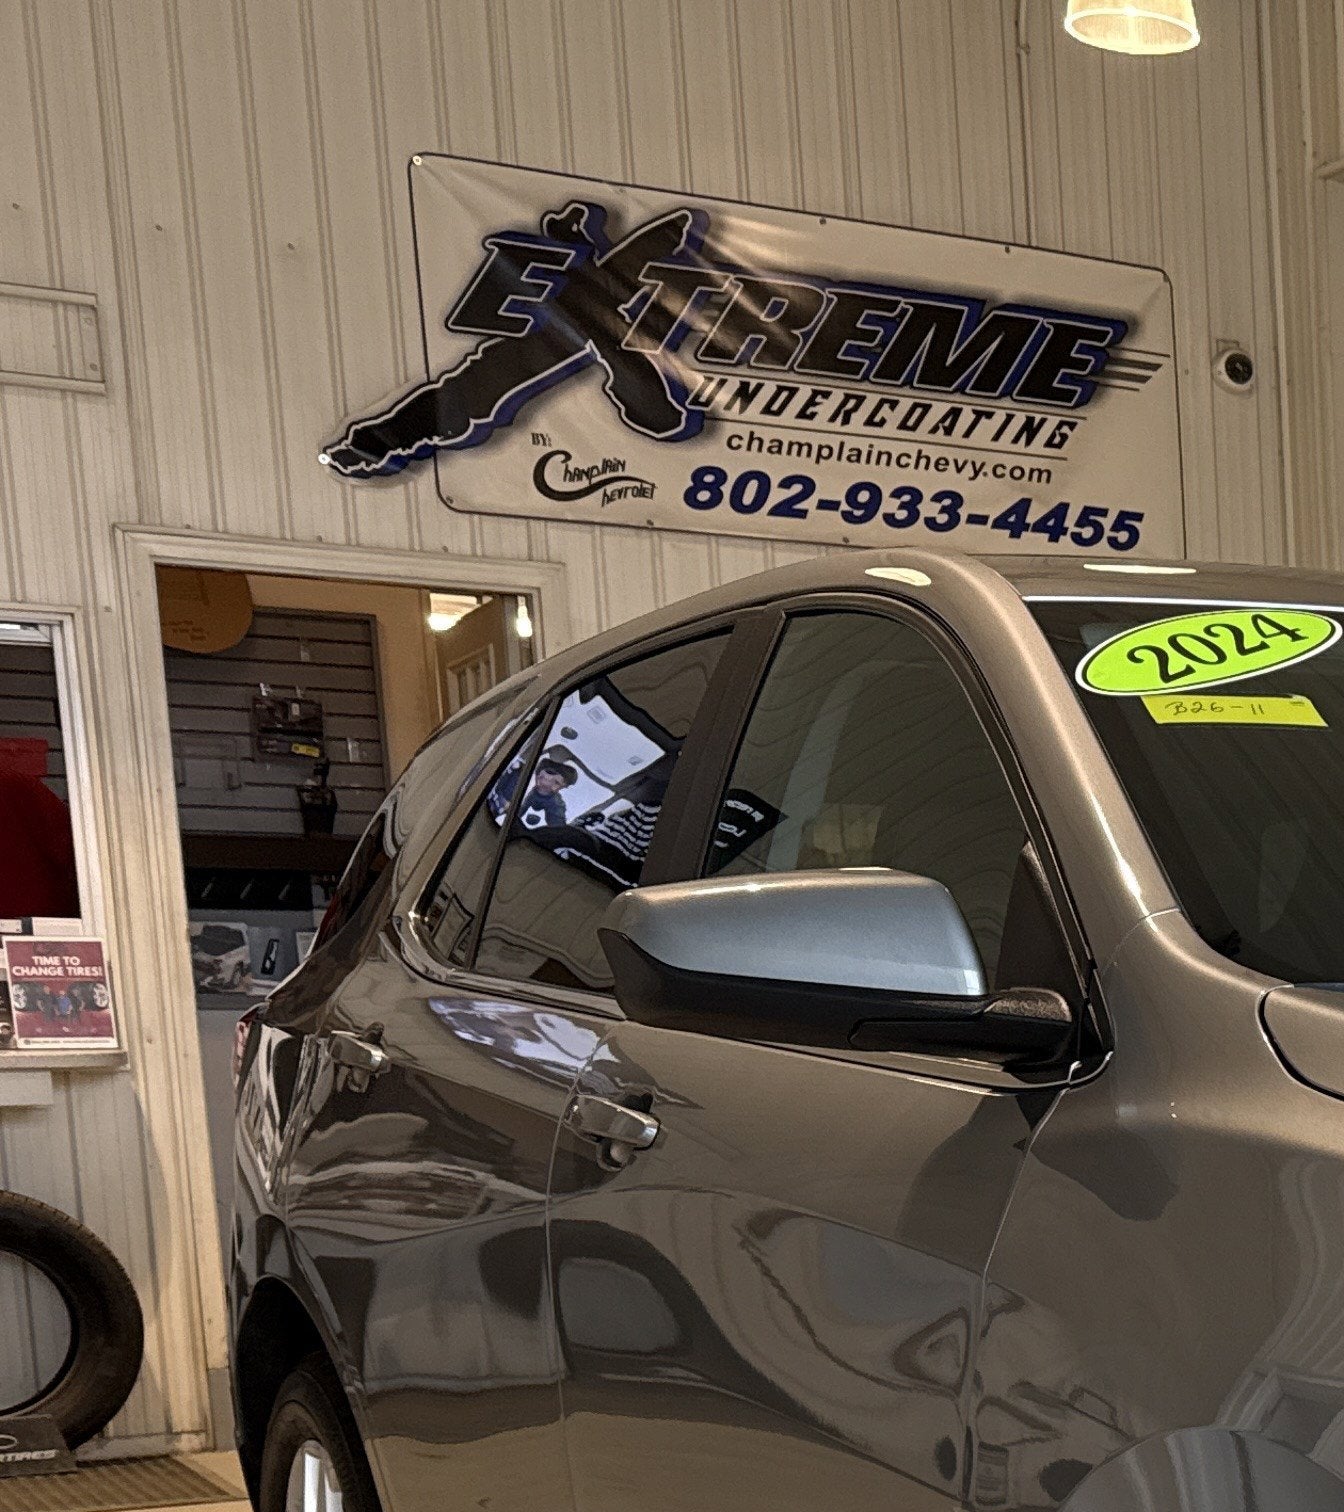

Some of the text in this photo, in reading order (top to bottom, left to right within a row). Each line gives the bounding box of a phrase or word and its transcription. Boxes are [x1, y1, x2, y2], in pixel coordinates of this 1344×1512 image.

[687, 376, 1078, 450] UNDERCOATING
[725, 431, 1053, 484] champlainchevy.com
[682, 465, 1145, 552] 802-933-4455
[1126, 613, 1310, 684] 2024
[12, 966, 103, 977] CHANGE TIRES!
[32, 955, 81, 966] TIME TO
